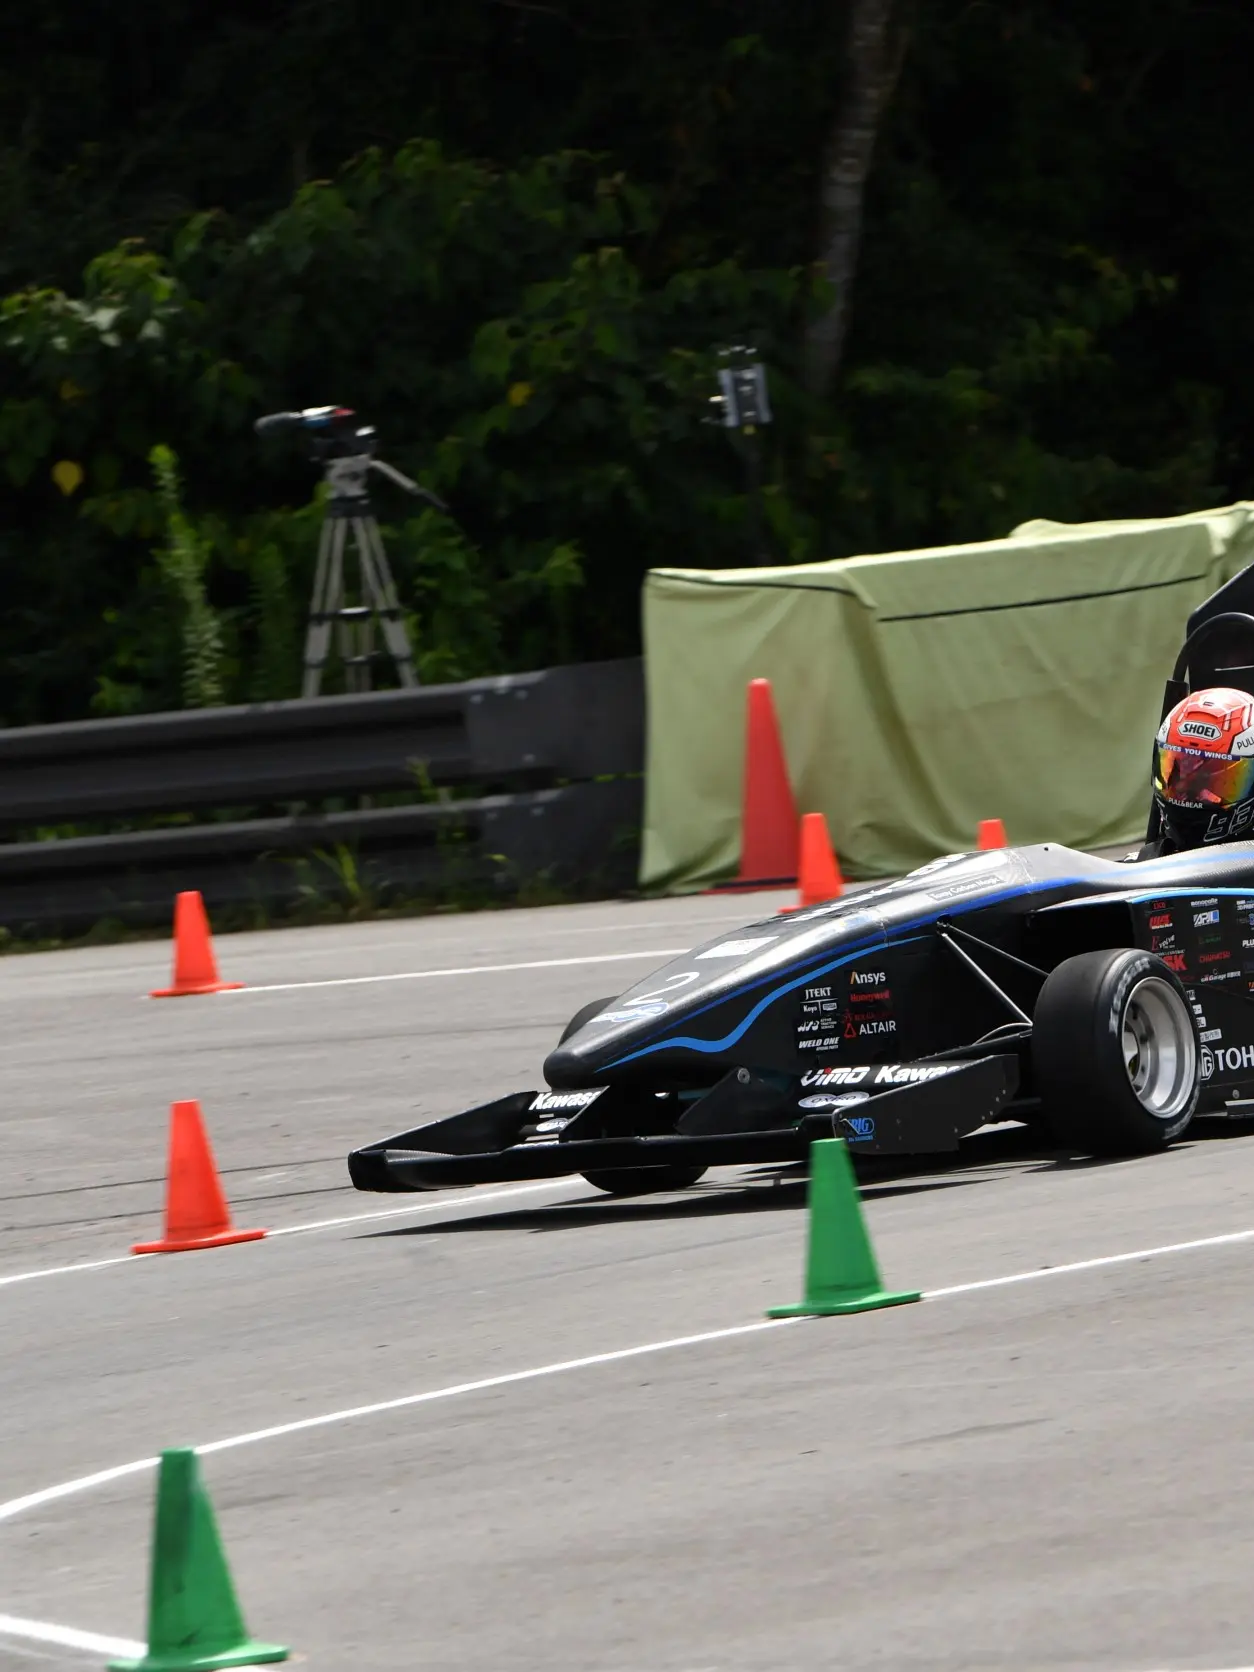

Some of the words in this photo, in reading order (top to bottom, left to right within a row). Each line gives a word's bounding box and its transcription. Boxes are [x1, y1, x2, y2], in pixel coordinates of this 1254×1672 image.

[1183, 723, 1216, 738] SHOEI
[1163, 743, 1182, 752] GIVES
[1185, 747, 1202, 757] YOU
[1204, 751, 1234, 761] WINGS
[1168, 797, 1204, 809] PULL&BEAR
[850, 971, 887, 985] Ansys
[805, 987, 832, 1001] JTEKT
[859, 1020, 898, 1036] ALTAIR
[799, 1039, 822, 1049] WELD
[823, 1037, 840, 1046] ONE
[875, 1065, 960, 1083] Kawa
